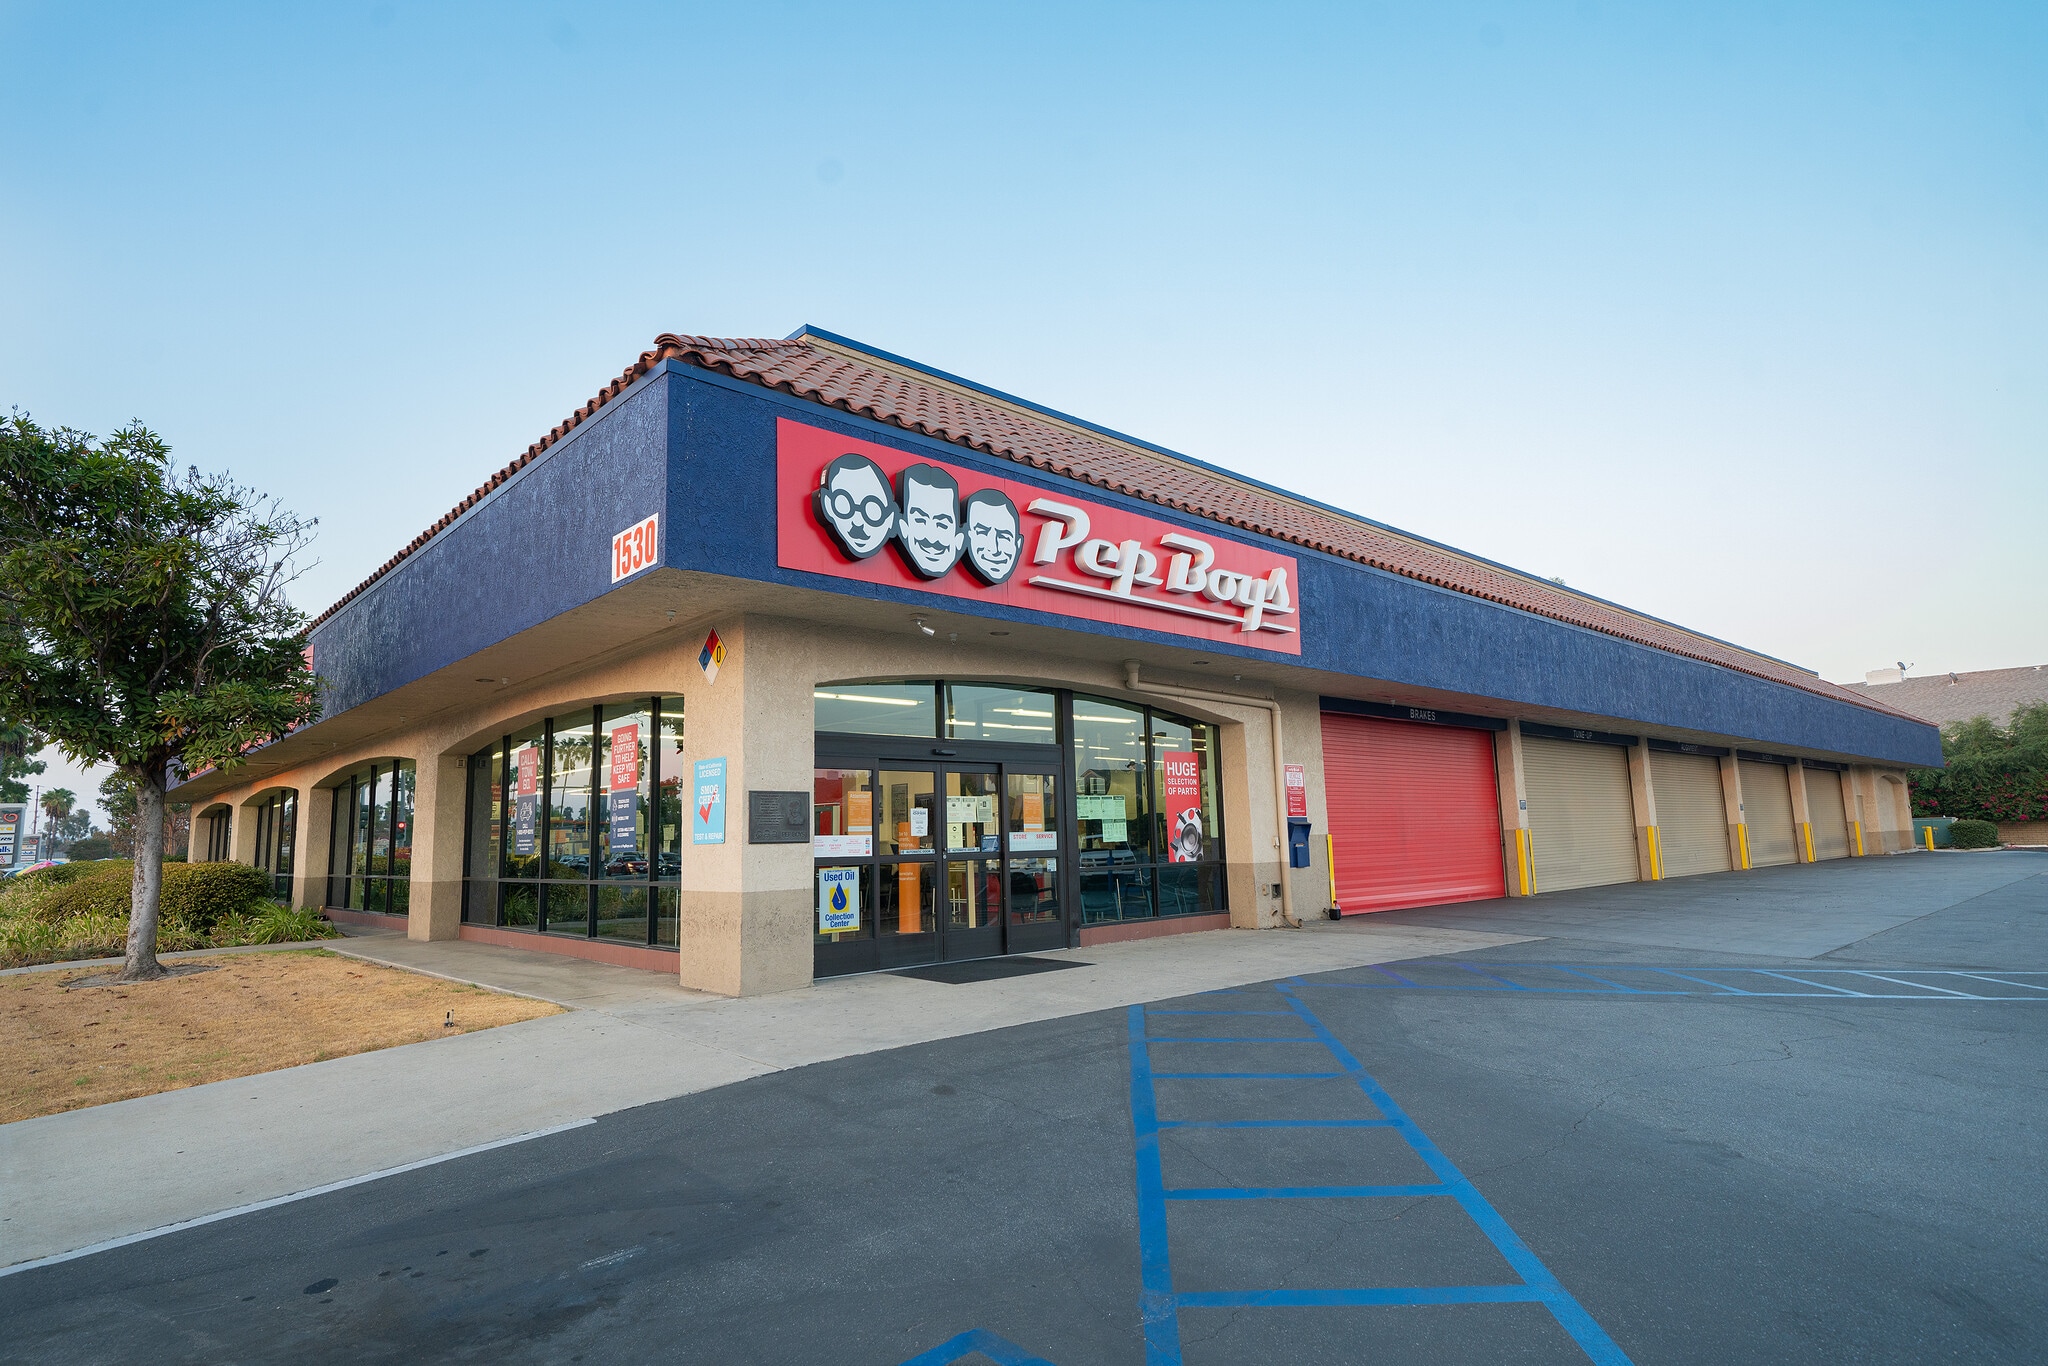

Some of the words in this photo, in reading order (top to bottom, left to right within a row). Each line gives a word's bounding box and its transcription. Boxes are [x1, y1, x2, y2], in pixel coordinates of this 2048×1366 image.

[614, 520, 656, 578] 1530
[1027, 498, 1164, 597] Pep
[1160, 532, 1296, 632] Boys
[1410, 708, 1436, 721] BRAKES
[617, 732, 632, 744] GOING
[1573, 729, 1593, 740] TUNE-UP
[613, 741, 636, 755] FURTHER
[615, 754, 621, 765] TO
[621, 752, 635, 763] HELP
[613, 763, 625, 775] KEEP
[625, 761, 636, 773] YOU
[699, 768, 721, 778] LICENSED
[1166, 761, 1197, 777] HUGE
[617, 773, 630, 784] SAFE
[1167, 777, 1197, 786] SELECTION
[700, 784, 719, 795] SMOG
[1168, 787, 1177, 796] OF
[1177, 787, 1198, 796] PARTS
[698, 794, 720, 805] CHECK
[695, 832, 704, 841] TEST
[708, 831, 723, 840] REPAIR
[824, 871, 843, 882] Used
[844, 871, 855, 881] Oil
[825, 912, 855, 922] Collection
[830, 920, 850, 928] Center
